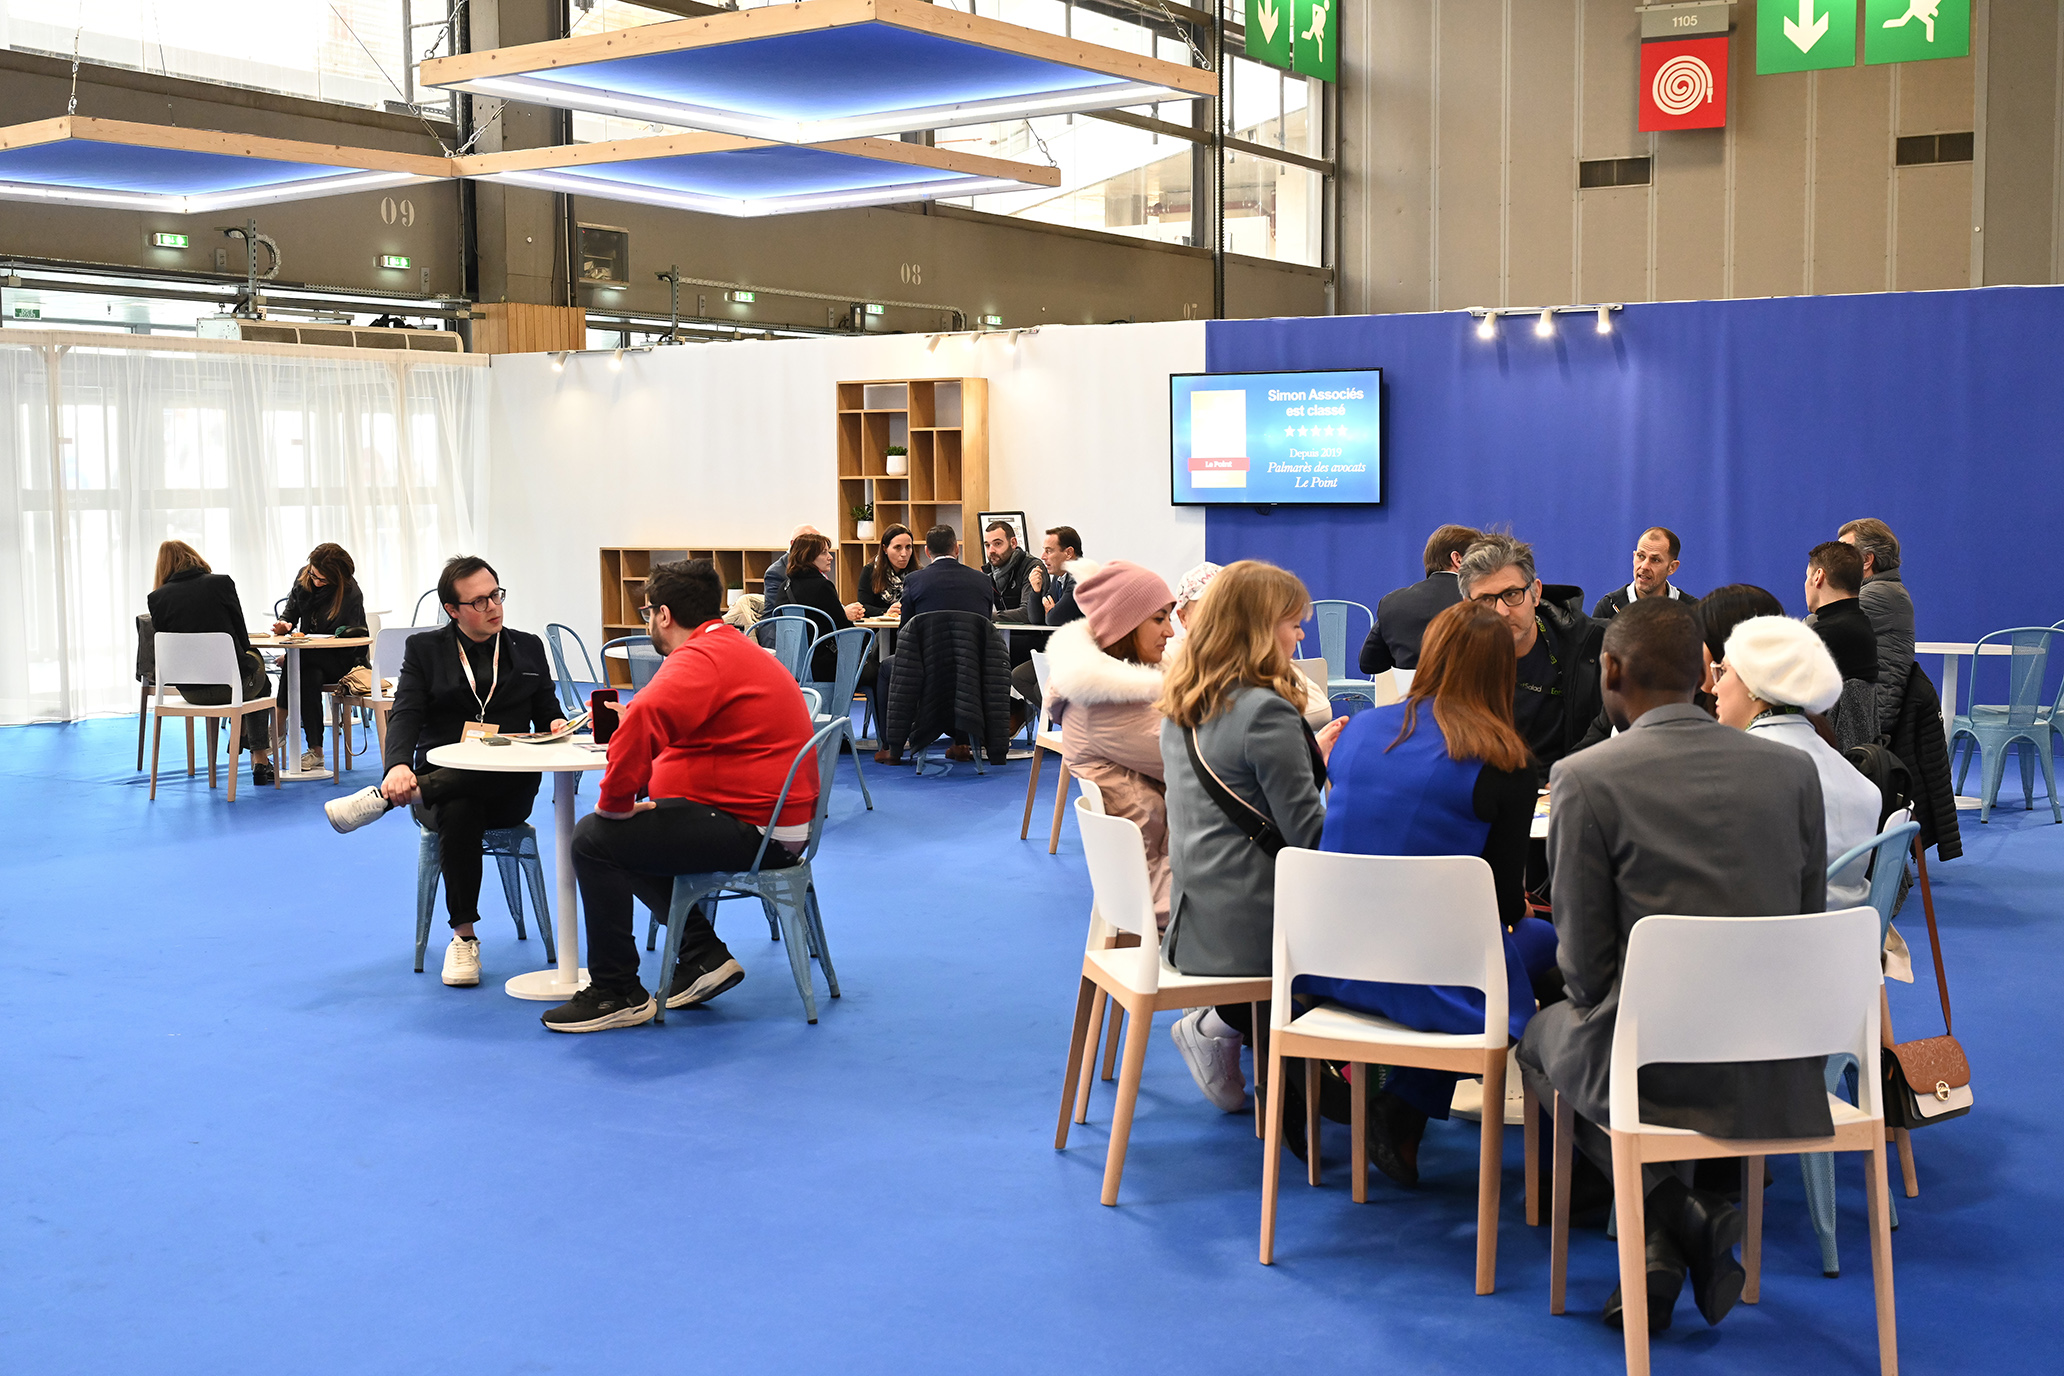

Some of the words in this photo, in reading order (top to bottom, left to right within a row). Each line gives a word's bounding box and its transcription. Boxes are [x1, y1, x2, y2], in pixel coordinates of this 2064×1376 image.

[1672, 15, 1698, 27] 1105
[380, 196, 415, 227] 09
[900, 262, 922, 285] 08
[1267, 389, 1307, 402] Simon
[1308, 387, 1365, 401] Associés
[1285, 404, 1305, 417] est
[1307, 403, 1346, 416] classé
[1289, 448, 1319, 460] Depuis
[1320, 447, 1343, 458] 2019
[1204, 460, 1213, 468] Le
[1213, 460, 1233, 468] Point
[1266, 461, 1312, 473] Palmarès
[1313, 461, 1329, 473] des
[1330, 461, 1366, 473] avocats
[1294, 476, 1309, 488] Le
[1310, 476, 1338, 488] Point
